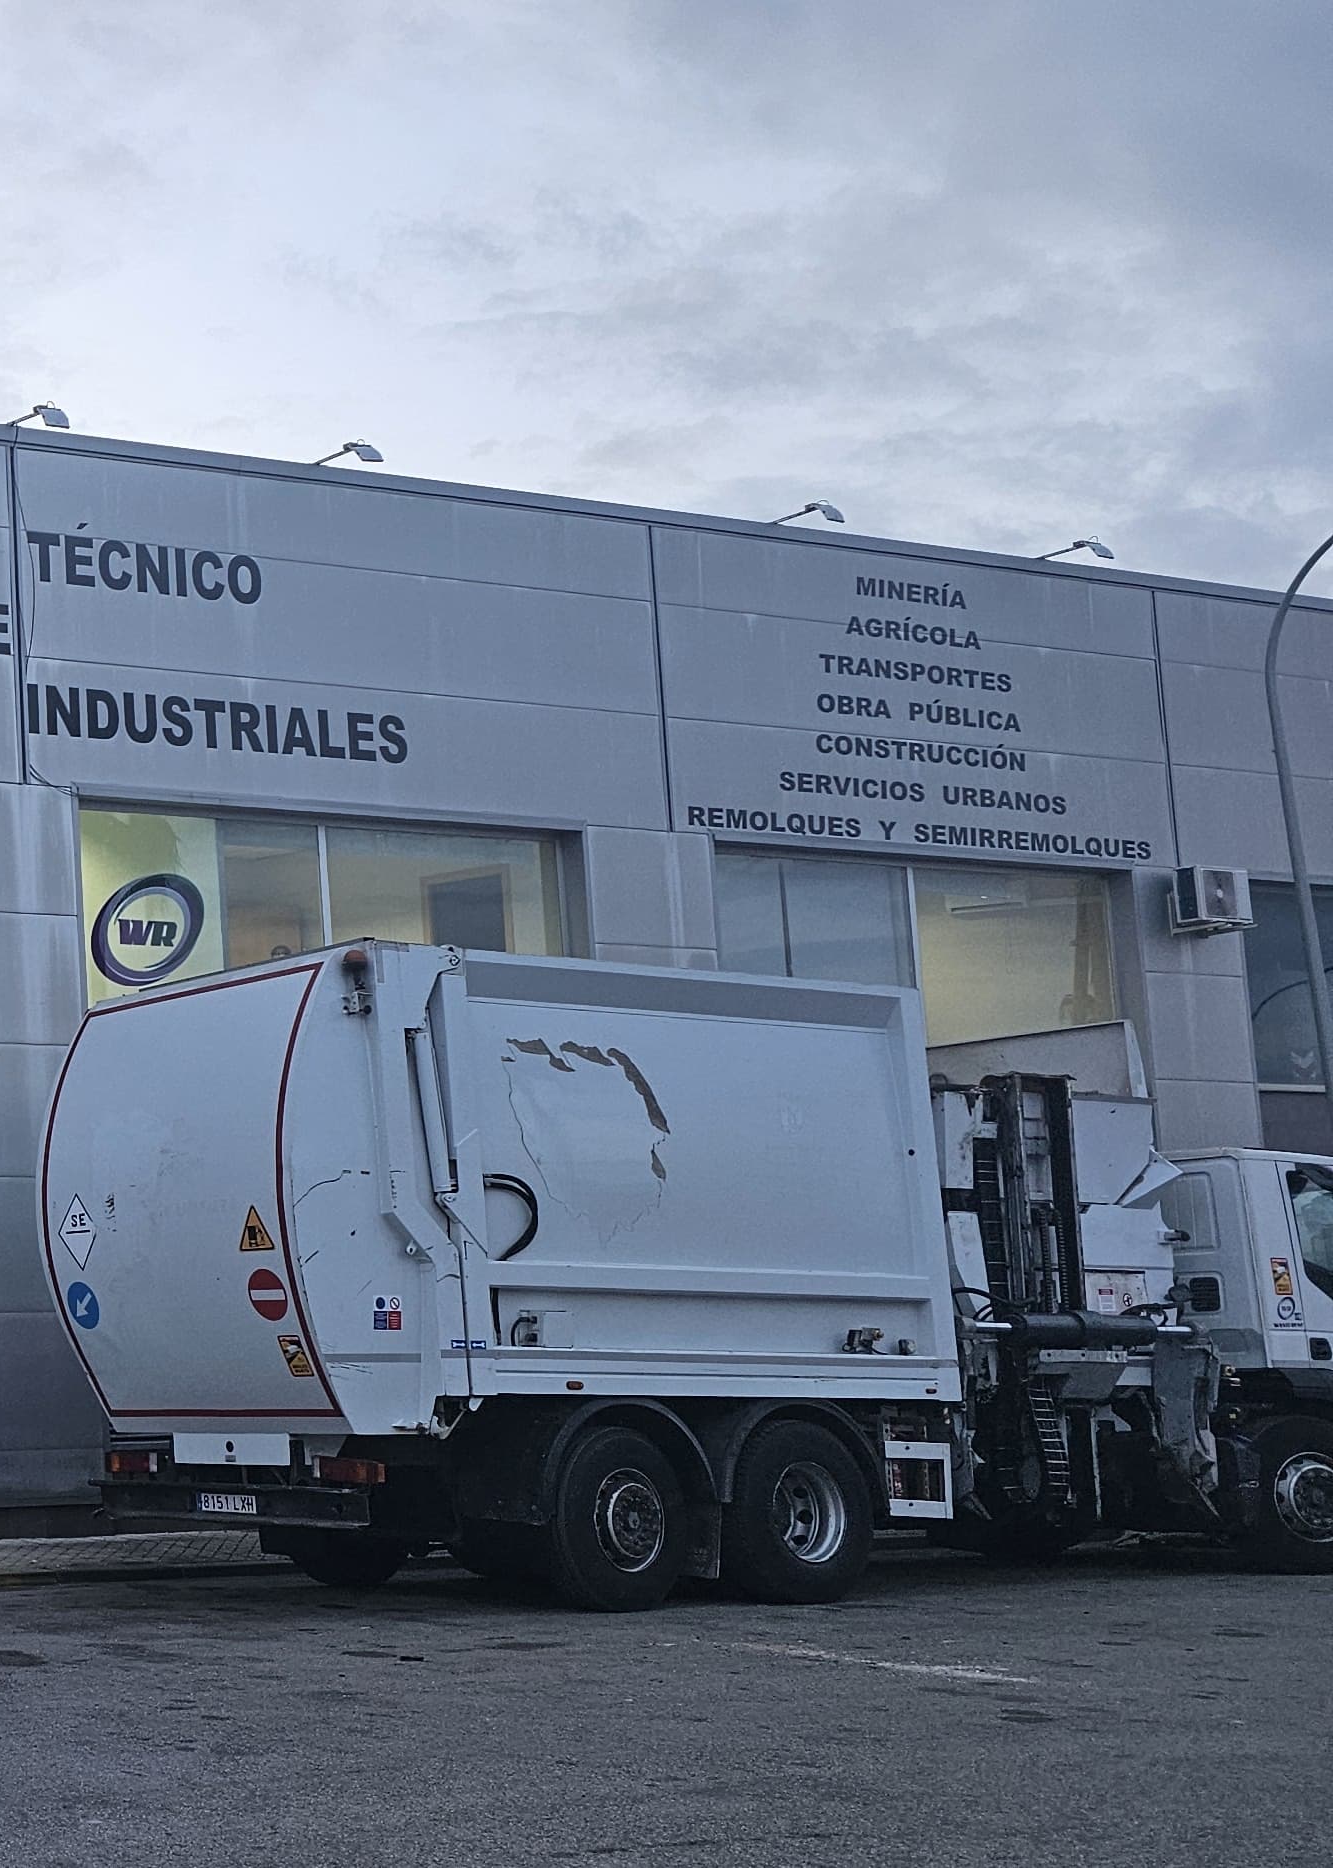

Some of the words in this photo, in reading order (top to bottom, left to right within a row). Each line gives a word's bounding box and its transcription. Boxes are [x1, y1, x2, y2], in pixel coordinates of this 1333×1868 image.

[26, 522, 262, 605] TÉCNICO
[855, 576, 967, 610] MINERÍA
[845, 615, 981, 651] AGRÍCOLA
[819, 654, 1013, 693] TRANSPORTES
[27, 683, 408, 765] INDUSTRIALES
[816, 693, 892, 720] OBRA
[908, 699, 1022, 733] PÚBLICA
[816, 733, 1027, 773] CONSTRUCCIÓN
[779, 771, 926, 804] SERVICIOS
[942, 785, 1067, 816] URBANOS
[687, 805, 862, 839] REMOLQUES
[878, 820, 897, 841] Y
[913, 823, 1152, 861] SEMIRREMOLQUES
[118, 918, 178, 947] WR
[71, 1213, 86, 1228] SE
[203, 1494, 230, 1510] 8151
[233, 1496, 254, 1511] LXH
